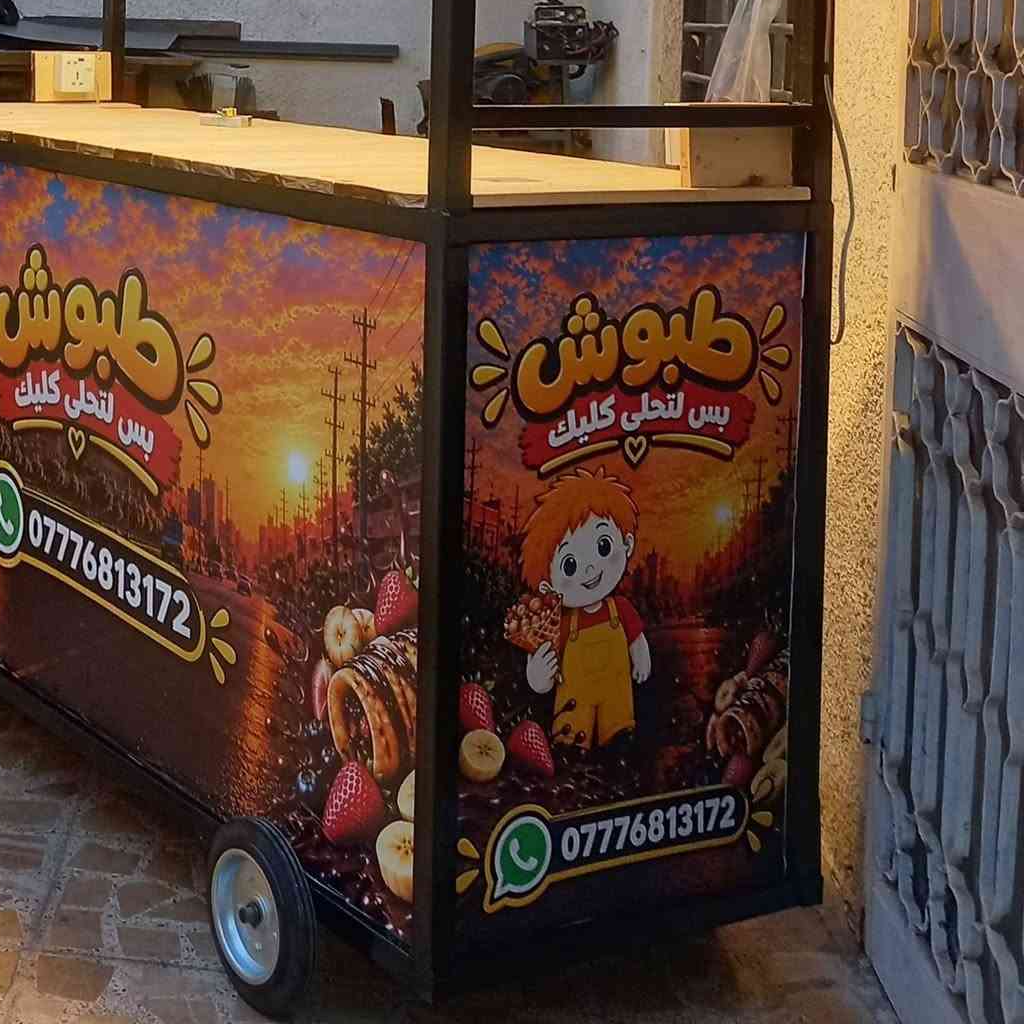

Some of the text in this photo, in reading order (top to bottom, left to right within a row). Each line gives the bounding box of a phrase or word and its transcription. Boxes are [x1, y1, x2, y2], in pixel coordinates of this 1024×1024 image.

[118, 416, 154, 462] بس
[688, 406, 730, 432] بس
[29, 509, 192, 637] 07776813172
[561, 795, 735, 861] 07776813172
